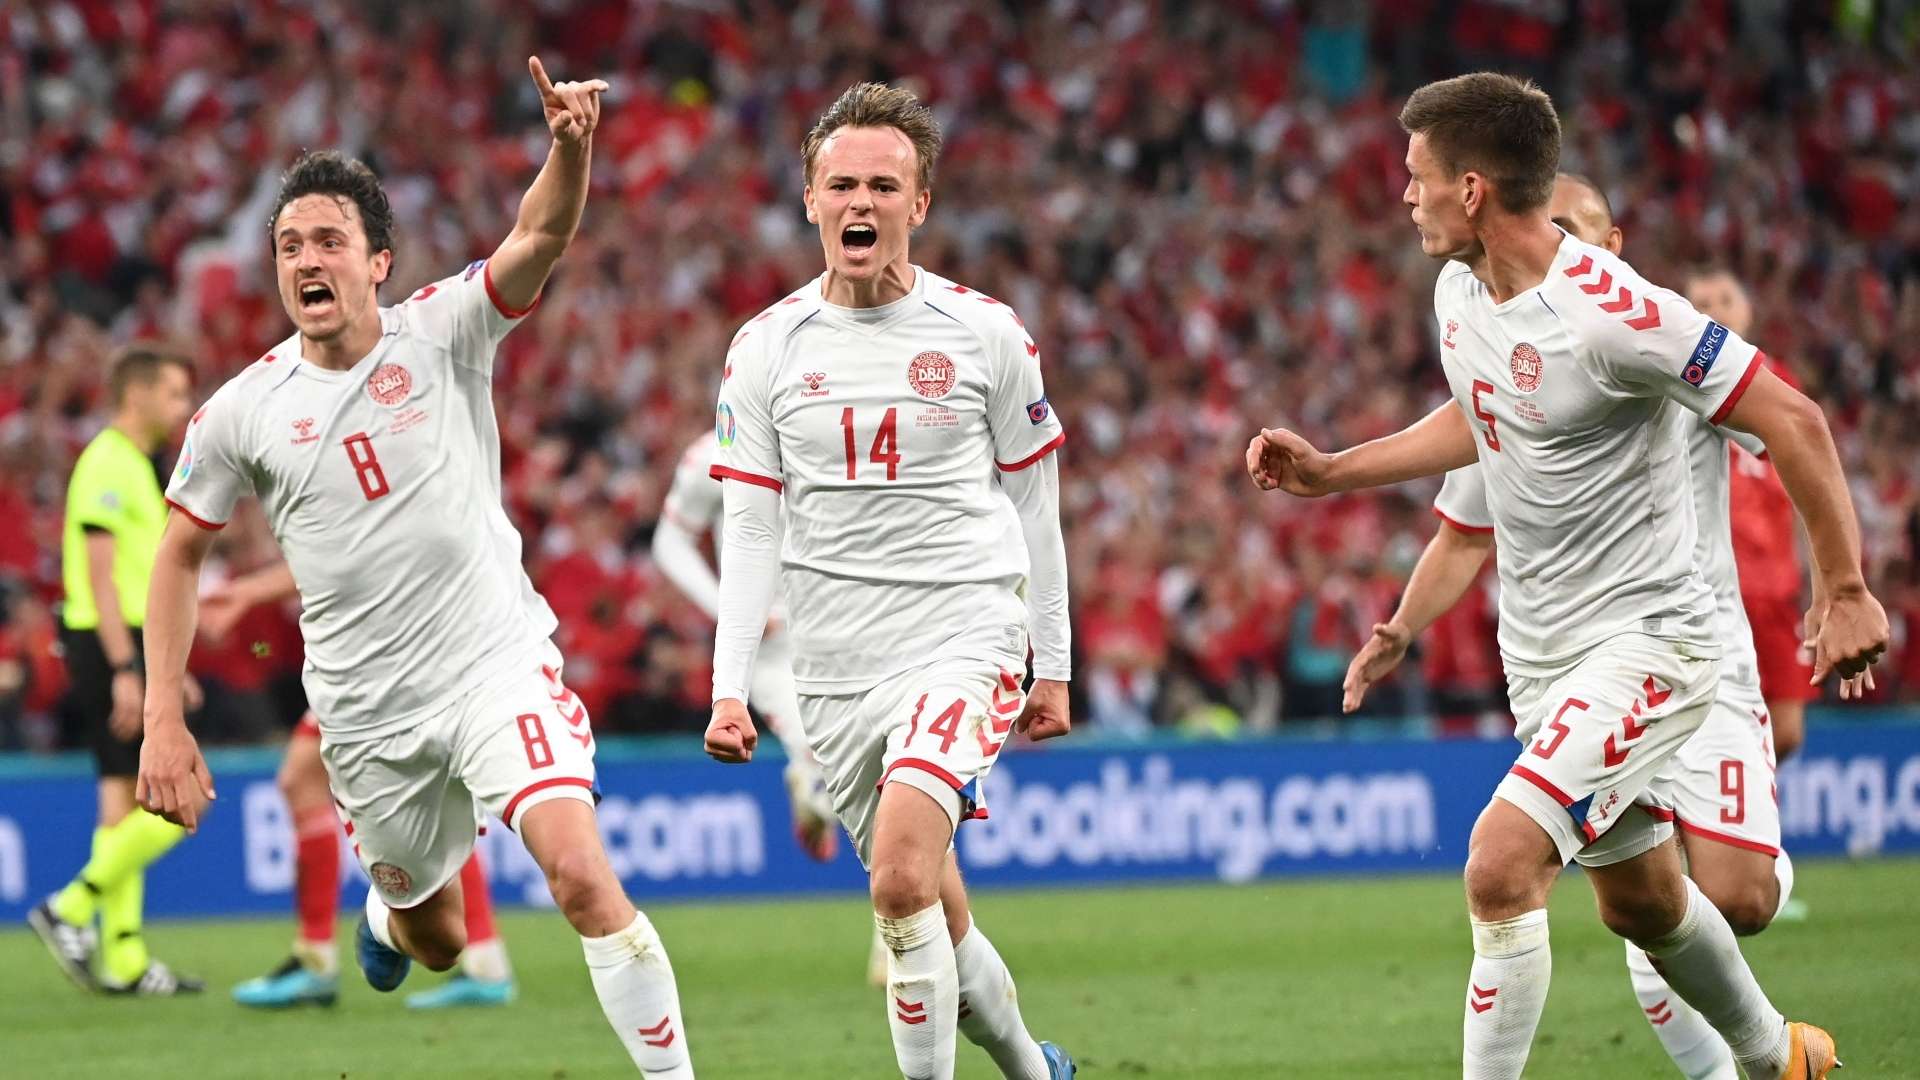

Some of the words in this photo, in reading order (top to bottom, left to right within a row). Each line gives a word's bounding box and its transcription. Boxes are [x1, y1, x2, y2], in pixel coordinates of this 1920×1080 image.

[917, 367, 946, 382] DBU
[1517, 358, 1537, 376] DBU
[1696, 324, 1723, 367] RESPECT
[375, 374, 403, 395] DBU
[840, 407, 901, 481] 14
[1472, 379, 1501, 453] 5
[342, 431, 390, 501] 8
[515, 713, 555, 770] 8
[903, 692, 968, 755] 14
[1530, 698, 1590, 760] 5
[1720, 760, 1745, 825] 9
